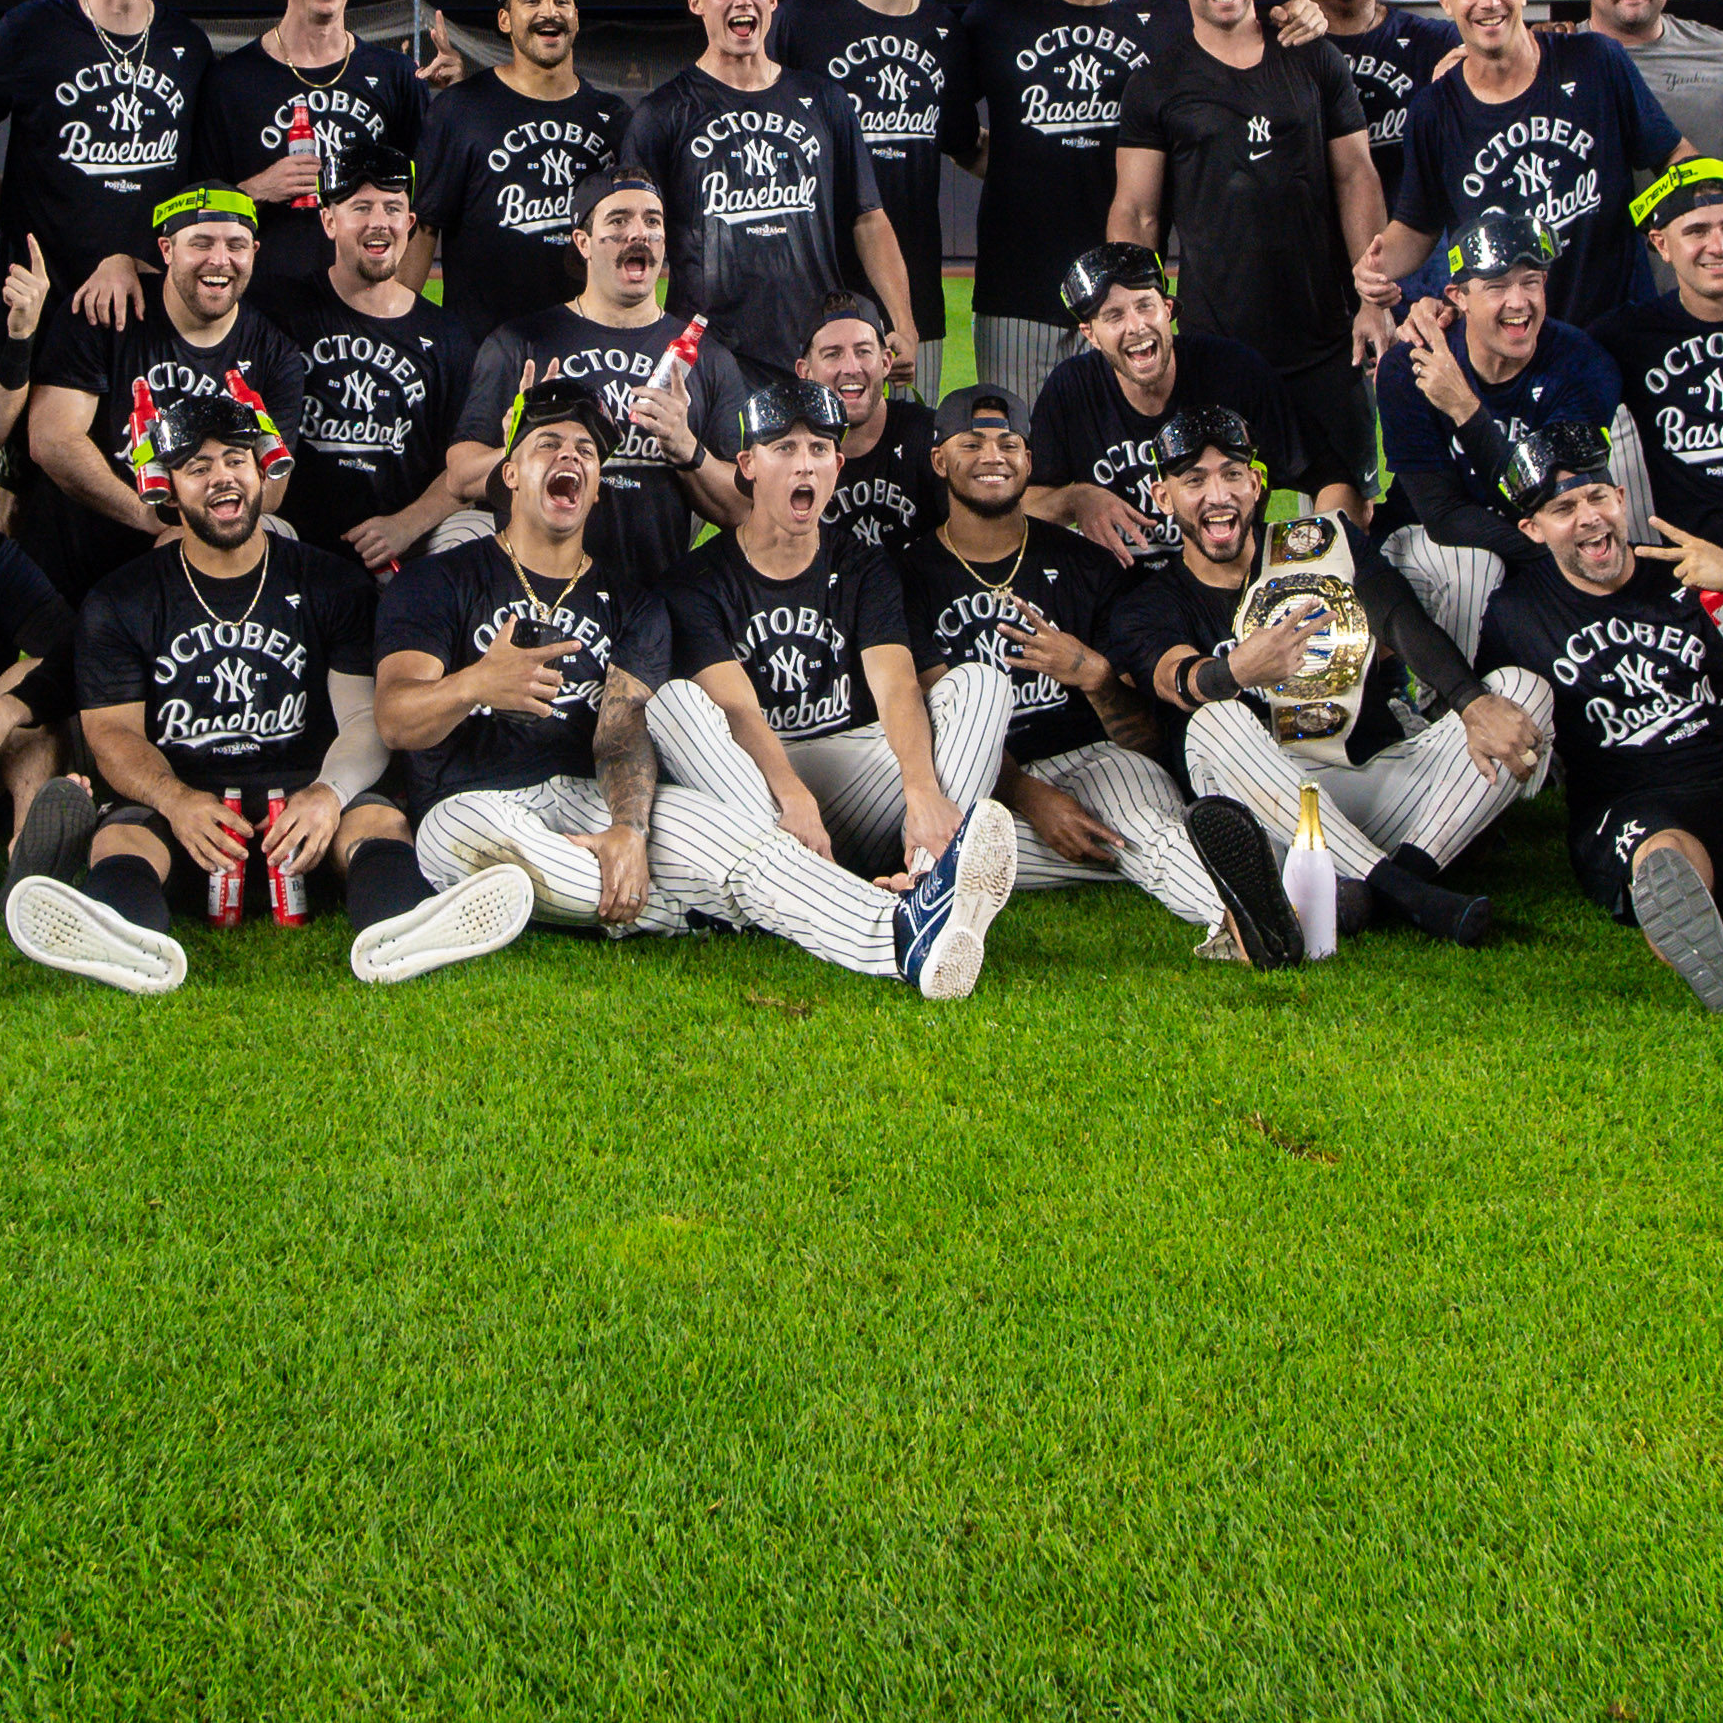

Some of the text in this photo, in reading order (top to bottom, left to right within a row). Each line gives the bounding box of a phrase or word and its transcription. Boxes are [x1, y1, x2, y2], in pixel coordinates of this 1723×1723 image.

[55, 61, 185, 119] OCTOBER
[828, 36, 945, 94] OCTOBER
[59, 122, 178, 171] Baseball
[488, 120, 614, 173] OCTOBER
[690, 111, 821, 164] OCTOBER
[1463, 116, 1594, 199] OCTOBER
[703, 171, 816, 219] Baseball
[299, 399, 412, 451] Baseball
[155, 621, 307, 684] OCTOBER
[1553, 616, 1706, 686] OCTOBER
[157, 691, 306, 746] Baseball
